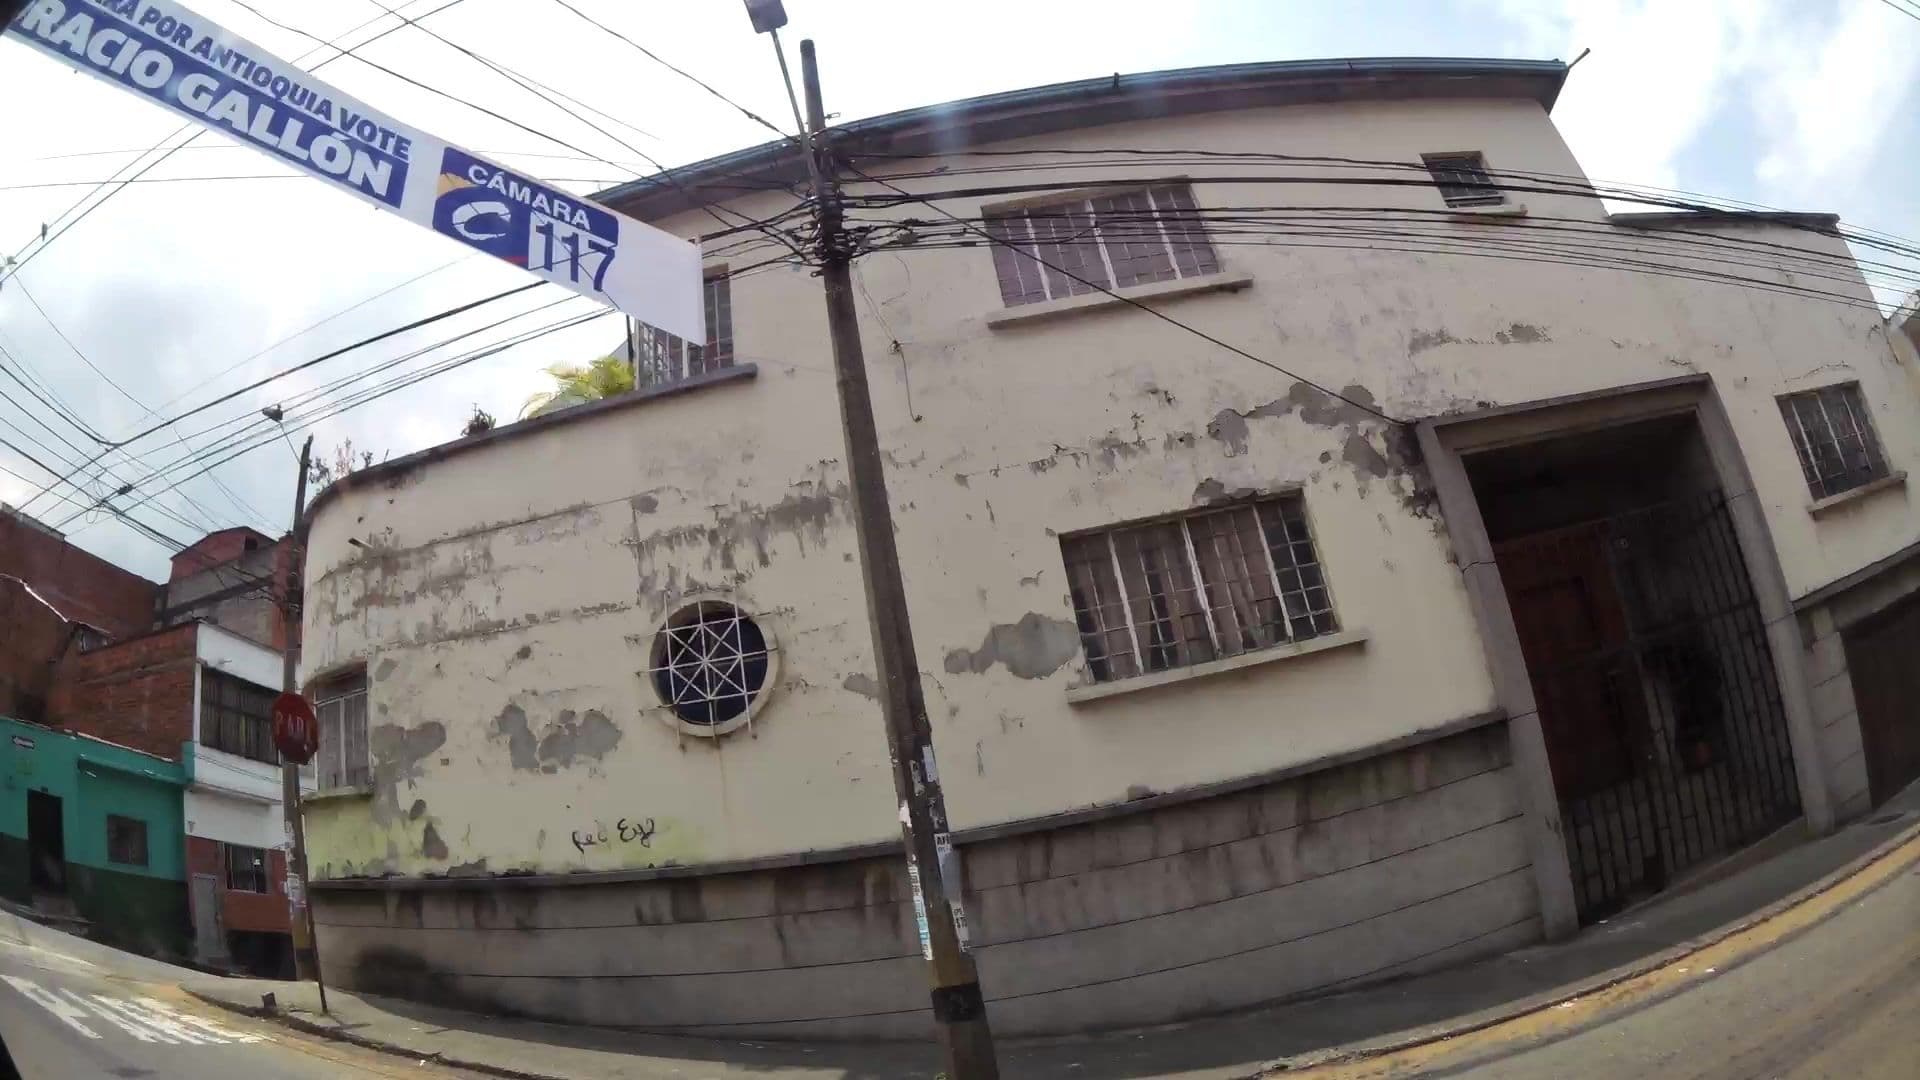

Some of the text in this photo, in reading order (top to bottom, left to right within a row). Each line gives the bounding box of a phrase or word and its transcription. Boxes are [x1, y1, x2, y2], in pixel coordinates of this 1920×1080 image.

[20, 0, 392, 196] RACIO GALLÓN
[138, 6, 193, 48] POR
[190, 36, 333, 122] ANTIOQUIA
[340, 107, 412, 163] VOTE
[467, 163, 591, 231] CÁMARA
[535, 215, 616, 291] 117
